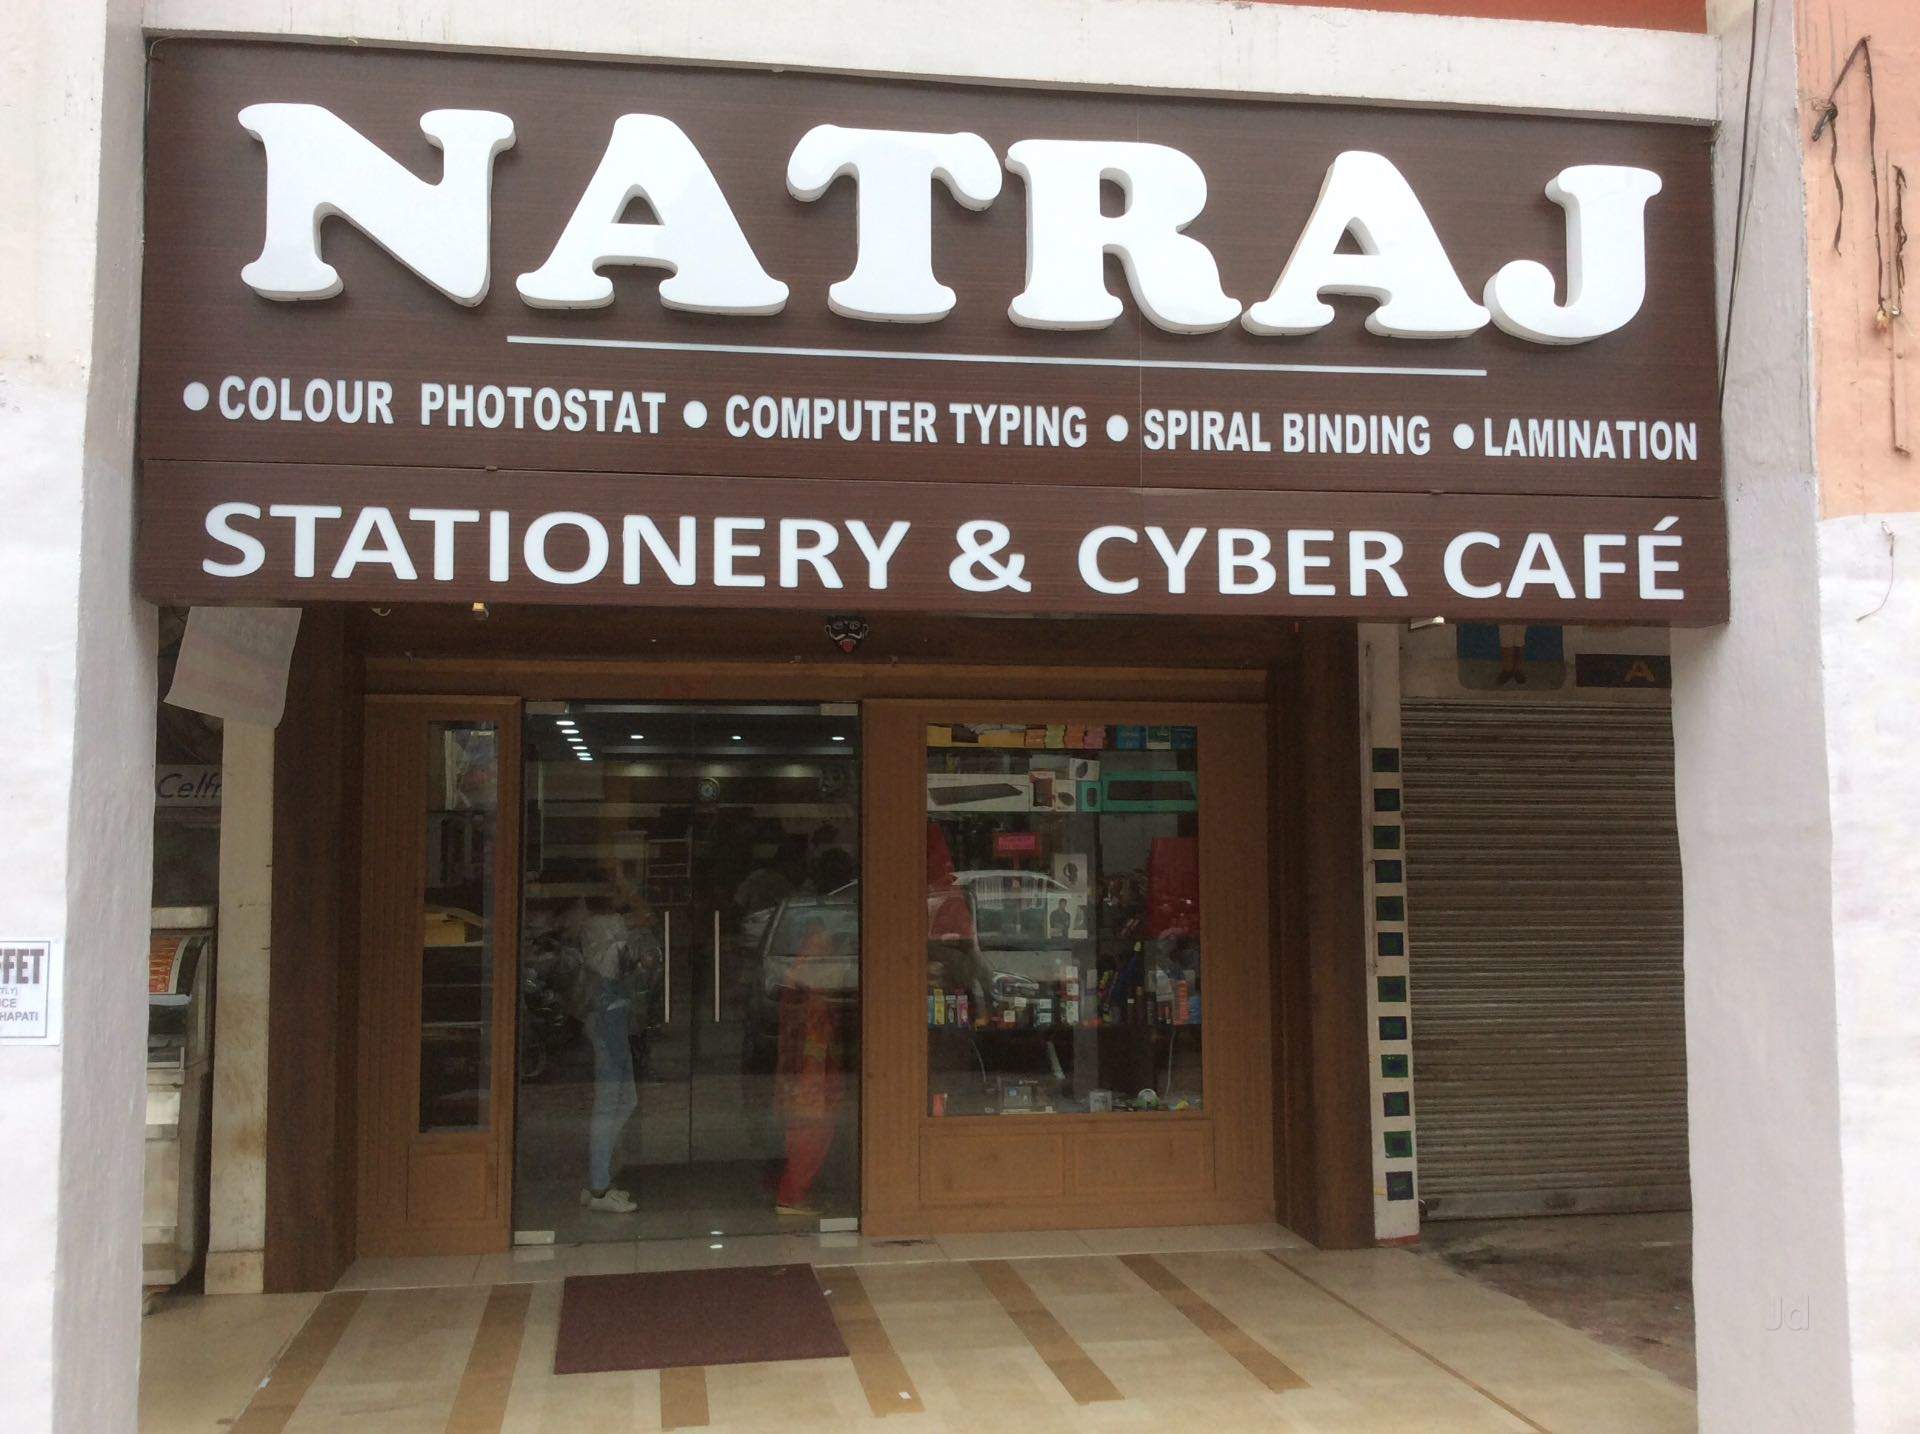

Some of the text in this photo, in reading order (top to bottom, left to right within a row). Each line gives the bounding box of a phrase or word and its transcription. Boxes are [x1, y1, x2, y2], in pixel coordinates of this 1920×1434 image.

[236, 101, 1664, 345] NATRAJ
[217, 375, 1698, 462] COLOUR PHOTOSTAT COMPUTER TYPING SPIRAL BINDING LAMINATION
[201, 501, 1686, 602] STATIONERY & CYBER CAFÉ
